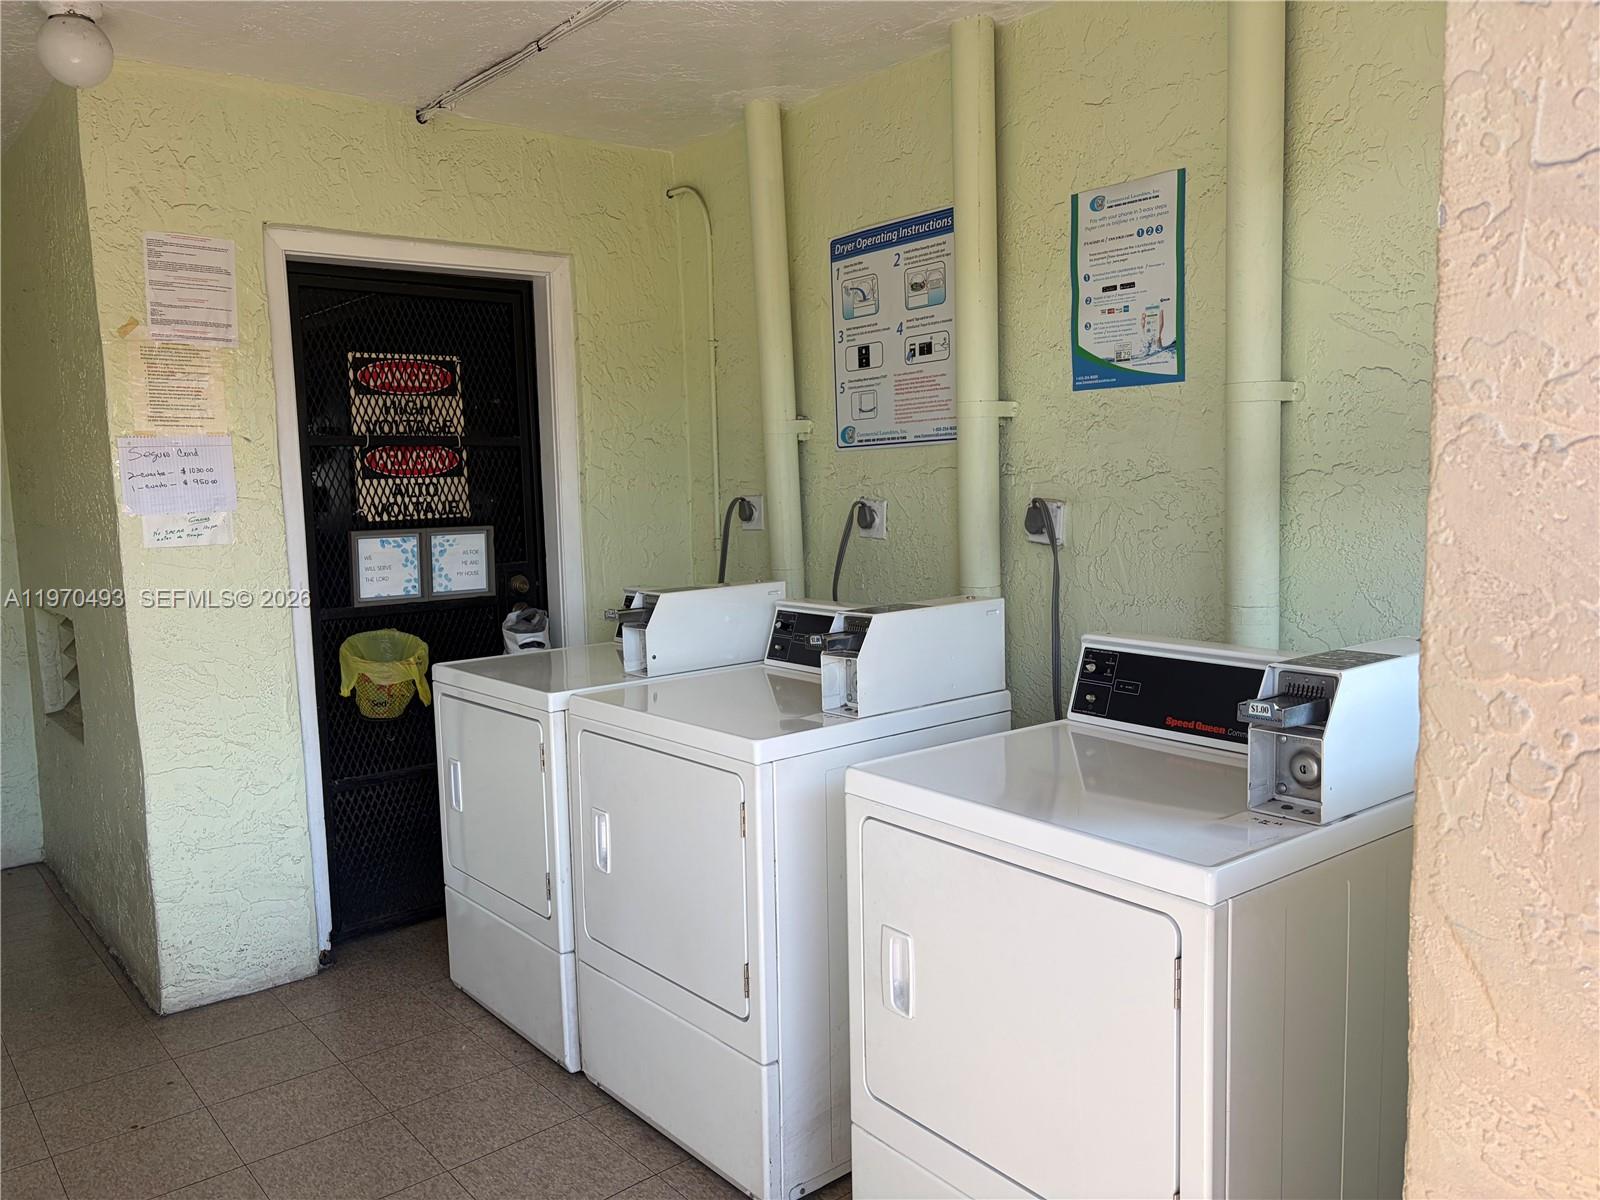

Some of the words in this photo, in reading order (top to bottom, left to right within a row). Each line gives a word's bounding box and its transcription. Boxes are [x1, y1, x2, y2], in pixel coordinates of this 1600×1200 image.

[834, 241, 855, 255] Dryer
[856, 231, 898, 250] Operating
[899, 216, 952, 239] Instructions
[893, 252, 901, 268] 2
[835, 267, 840, 281] 1
[896, 321, 903, 336] 4
[838, 330, 844, 344] 3
[840, 382, 845, 394] 5
[365, 420, 454, 435] VOLTAGE
[392, 482, 439, 498] ALTO
[1250, 704, 1269, 714] $1.00
[1165, 716, 1194, 729] Speed
[1195, 721, 1226, 735] Queen
